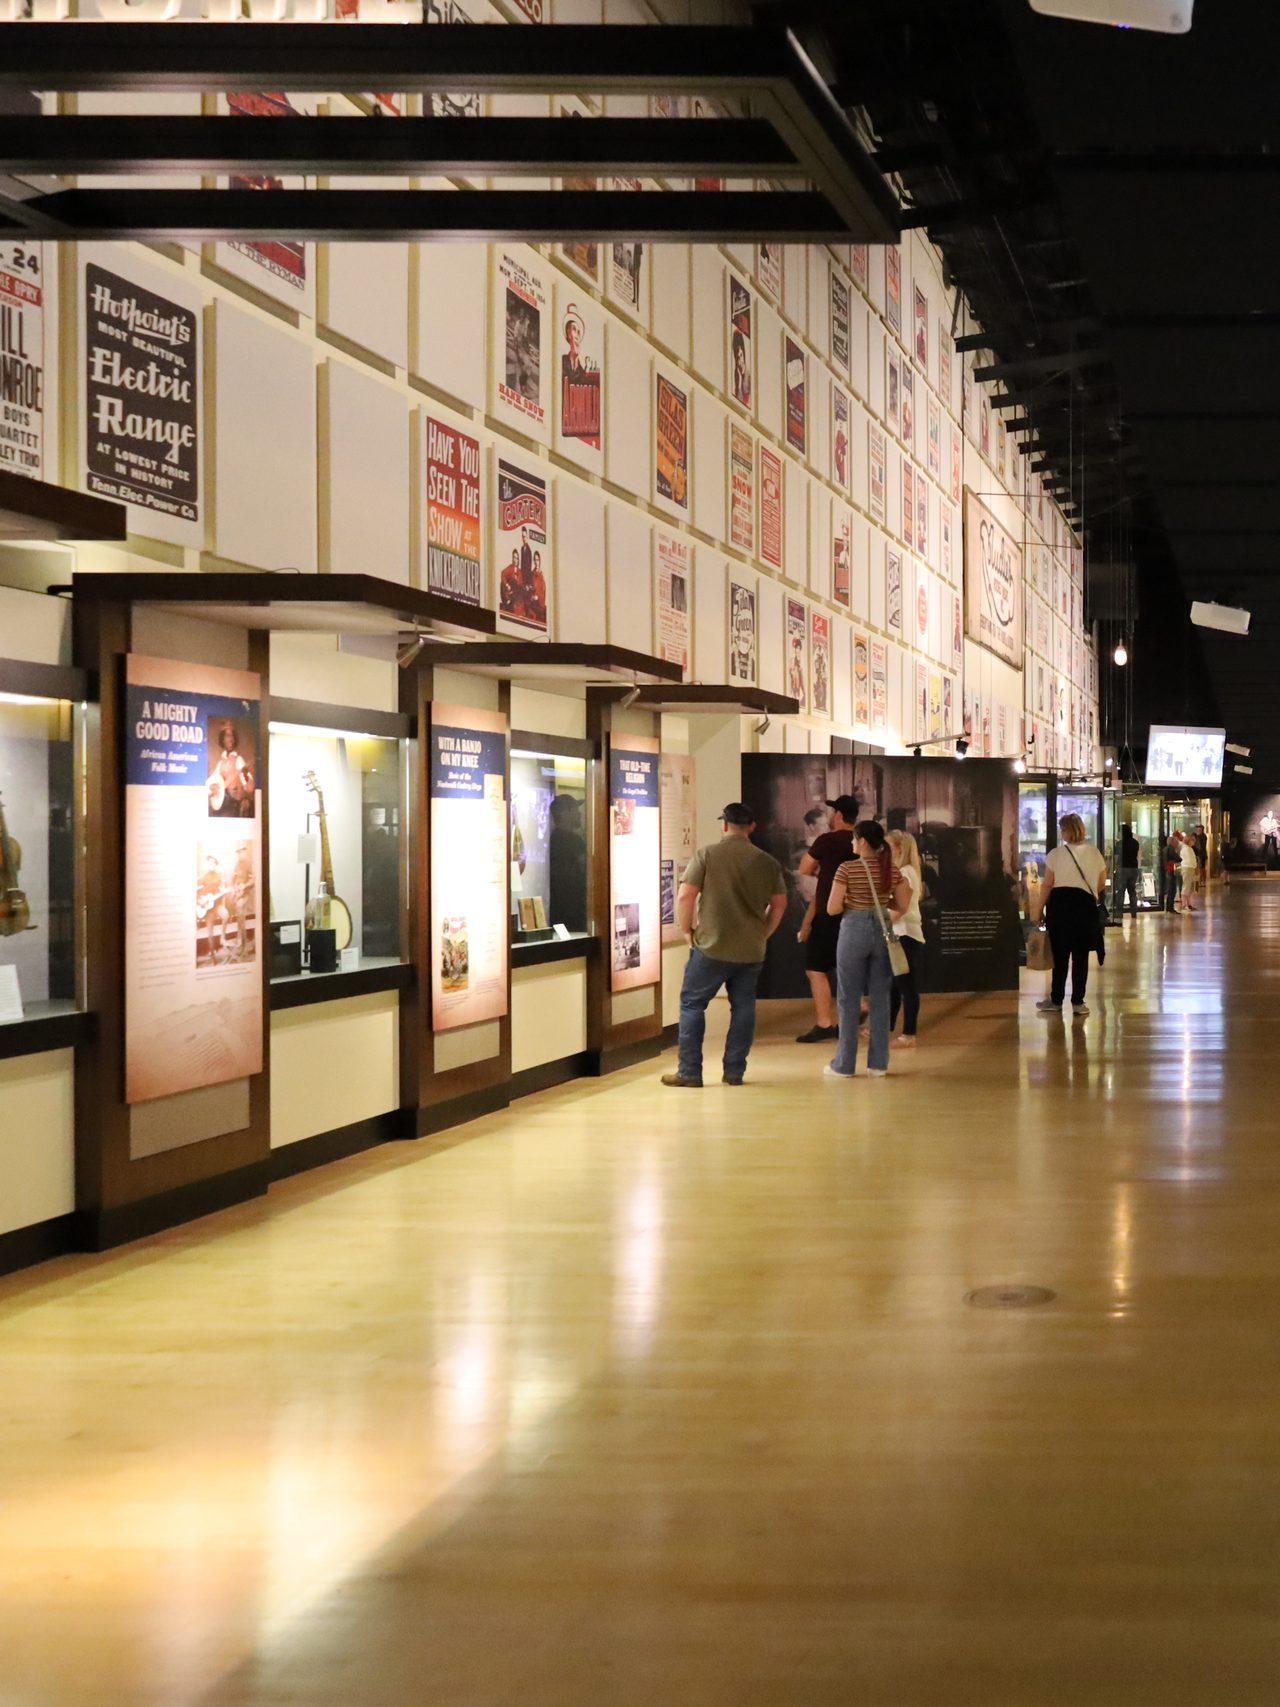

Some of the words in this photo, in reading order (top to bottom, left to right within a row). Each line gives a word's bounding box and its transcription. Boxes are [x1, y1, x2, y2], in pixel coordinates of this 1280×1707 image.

[0, 304, 28, 359] ILL
[90, 284, 191, 346] Hotpoint's
[98, 320, 129, 342] MOST
[131, 336, 187, 368] BEAUTIFUL
[89, 346, 192, 404] Electric
[4, 405, 30, 427] BOYS
[524, 399, 546, 419] SNOW
[0, 423, 38, 449] UARTET
[92, 394, 196, 465] Range
[96, 441, 111, 455] AT
[115, 447, 158, 471] LOWEST
[161, 463, 190, 482] PRICE
[428, 422, 455, 468] HAVE
[459, 437, 479, 479] YOU
[115, 462, 127, 475] IN
[130, 467, 174, 490] HISTORY
[428, 466, 456, 510] SEEN
[461, 478, 479, 517] THE
[145, 494, 180, 514] Power
[429, 506, 463, 553] SHOW
[142, 701, 151, 719] A
[153, 702, 198, 724] MIGHTY
[136, 721, 170, 741] GOOD
[171, 724, 204, 744] ROAD
[438, 736, 455, 751] WITH
[456, 738, 461, 752] A
[462, 739, 482, 754] BANJO
[440, 752, 451, 766] ON
[451, 753, 461, 767] MY
[461, 755, 479, 769] KNEE
